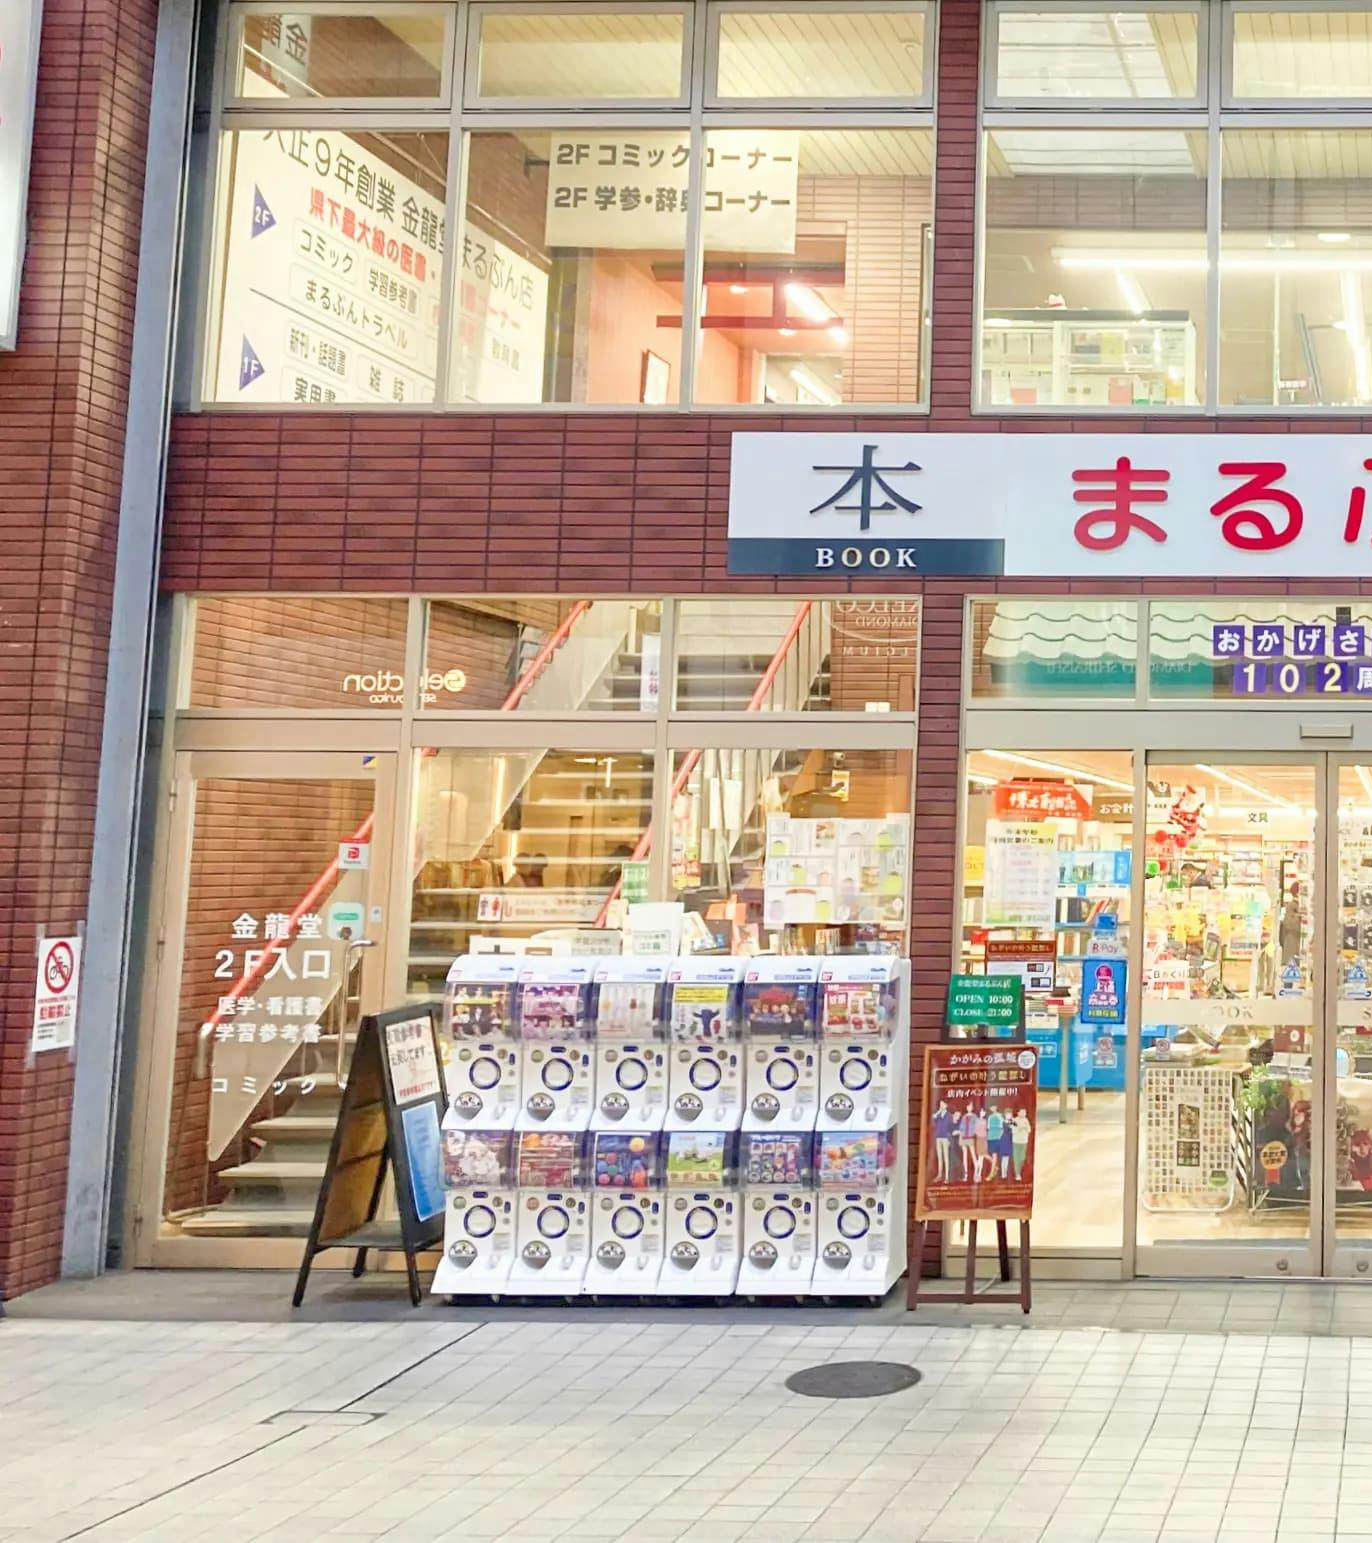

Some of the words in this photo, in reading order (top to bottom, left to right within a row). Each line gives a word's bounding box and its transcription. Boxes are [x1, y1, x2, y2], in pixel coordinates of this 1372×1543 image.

[557, 143, 590, 165] 2F
[554, 186, 588, 209] 2F
[253, 204, 271, 228] 2F
[300, 229, 353, 274] コミック
[305, 279, 408, 350] まるぶんトラベル
[242, 356, 260, 378] 1F
[809, 443, 923, 531] 本
[815, 546, 917, 570] BOOK
[1247, 813, 1269, 824] 文具
[232, 912, 323, 940] 金龍堂
[1101, 943, 1119, 955] Pay
[214, 948, 331, 980] 2F入口
[955, 994, 984, 1004] OPEN
[988, 995, 1014, 1004] 10:00
[215, 1023, 323, 1043] 学習参考書
[212, 1077, 317, 1095] コミック
